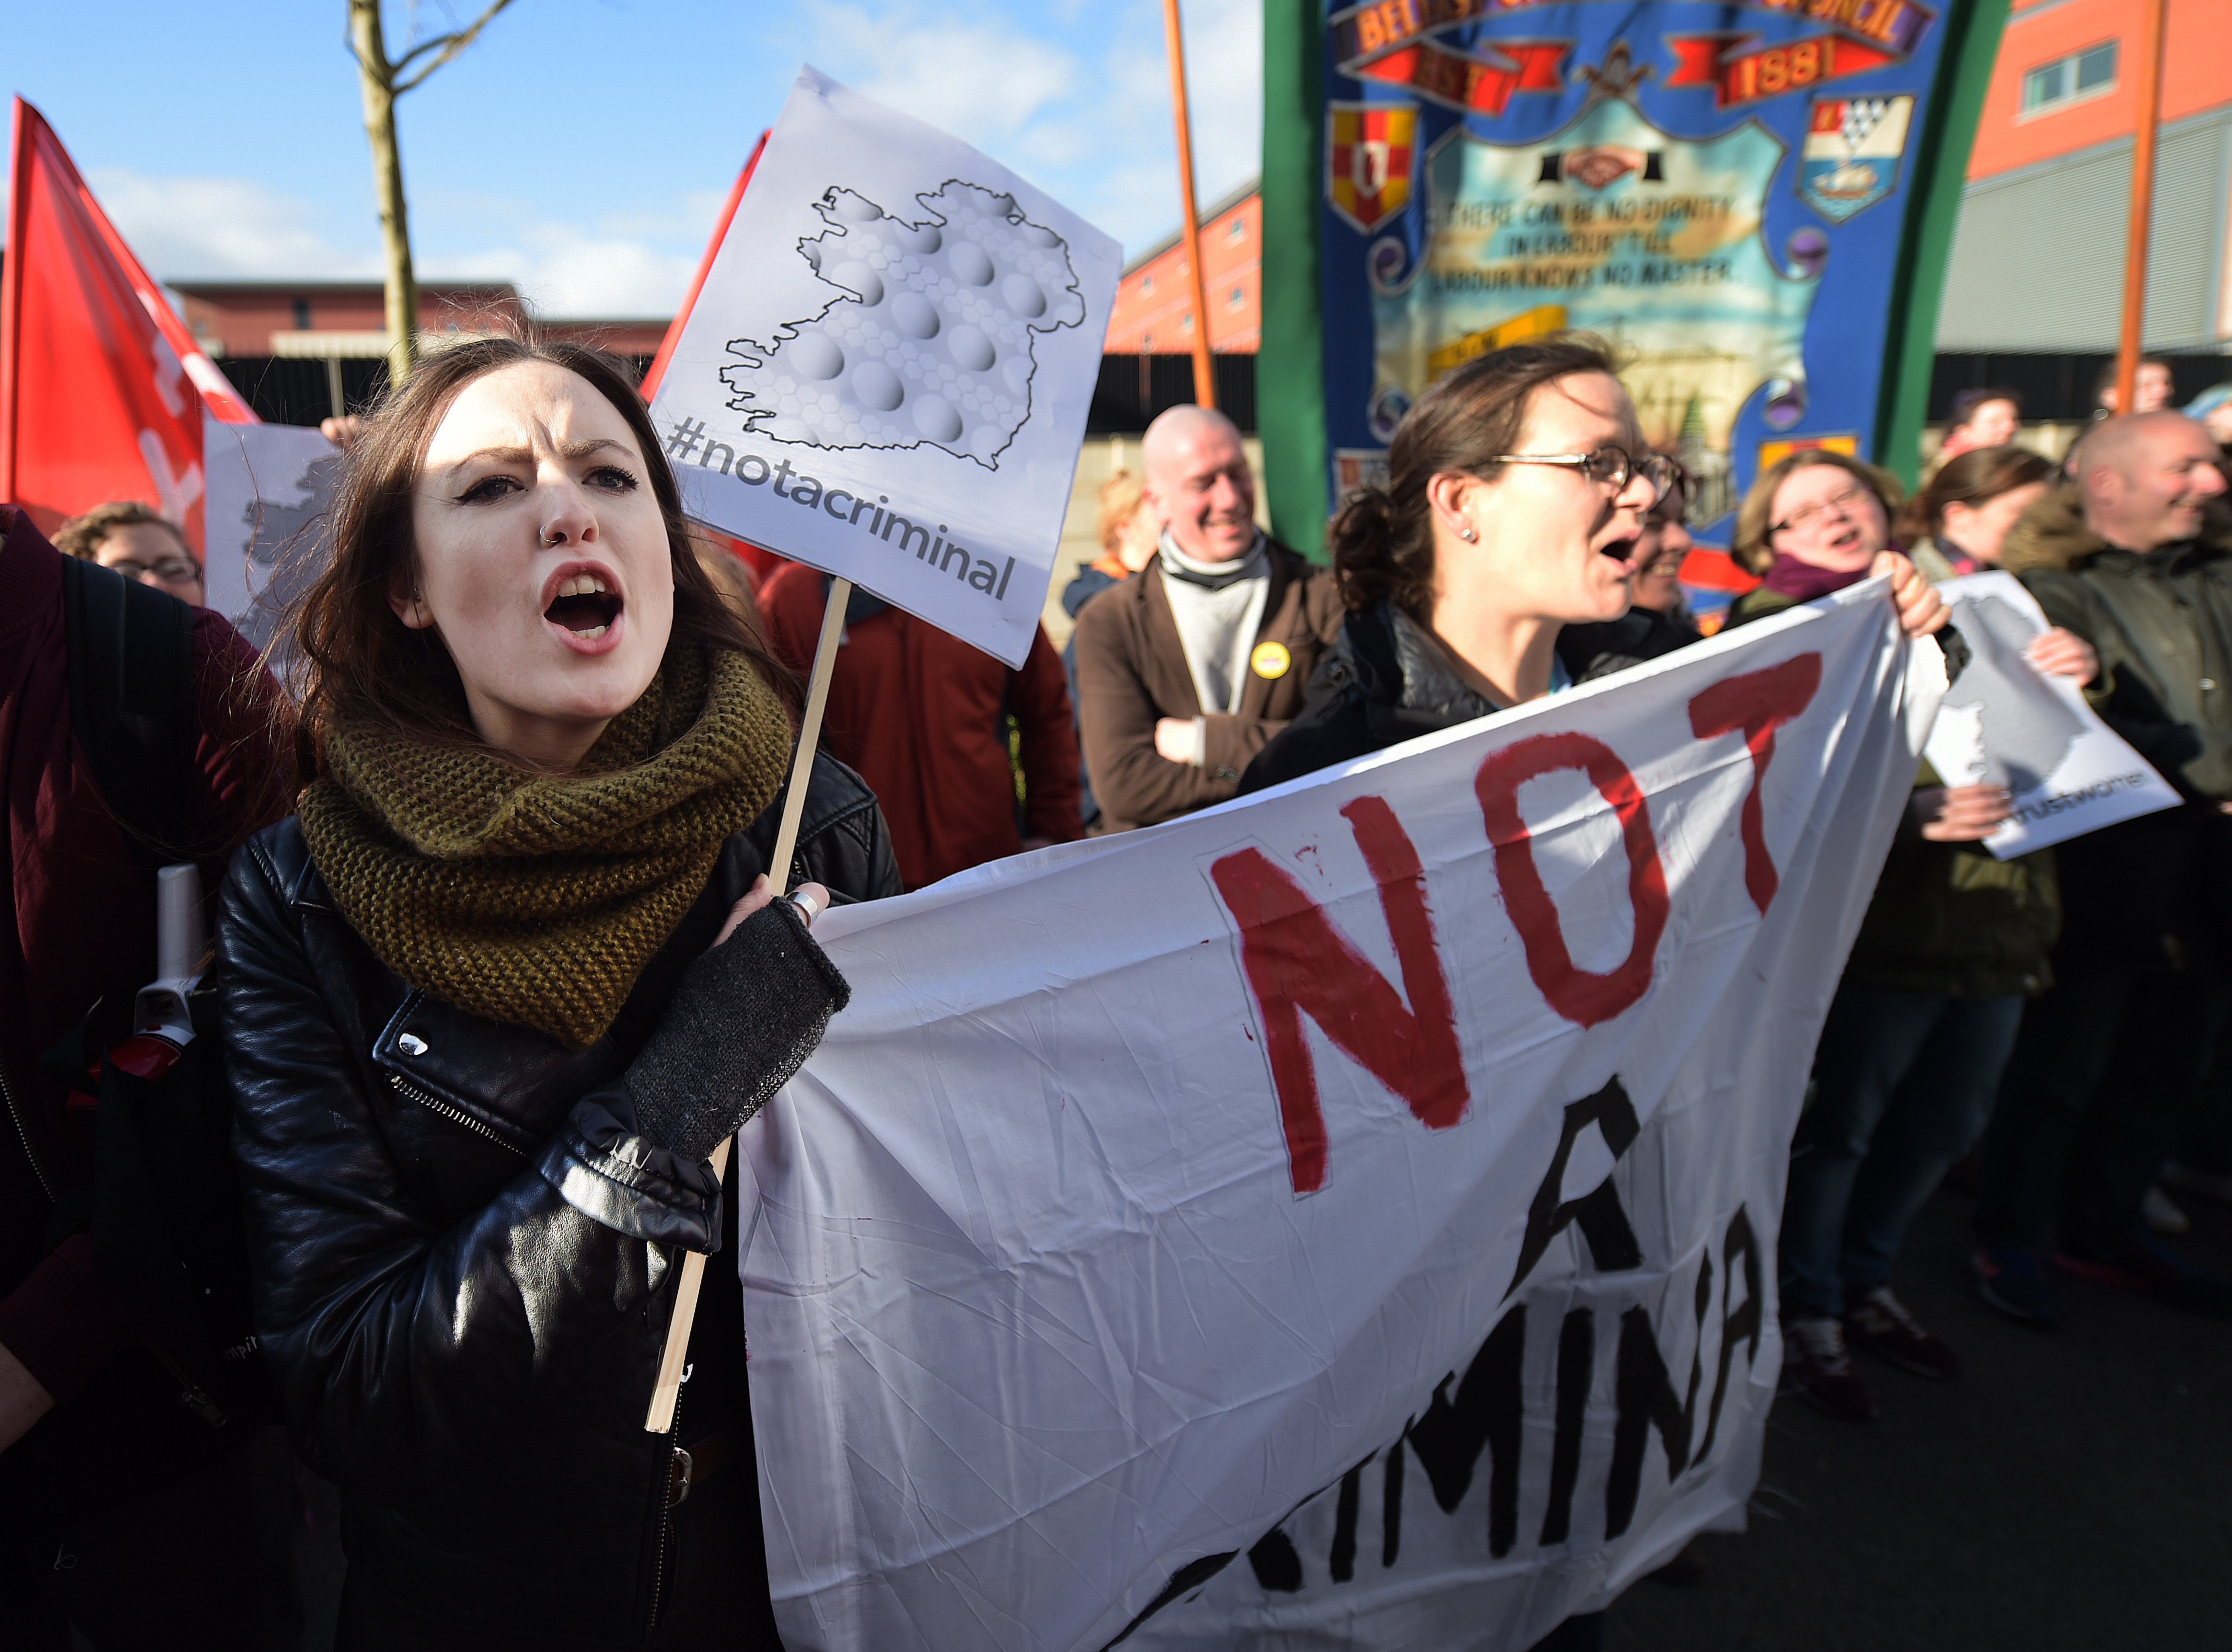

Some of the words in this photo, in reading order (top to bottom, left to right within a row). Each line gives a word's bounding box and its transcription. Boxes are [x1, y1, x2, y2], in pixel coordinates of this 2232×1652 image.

[1740, 35, 1836, 99] 1881
[1523, 200, 1564, 226] CAN
[1572, 199, 1596, 223] BE
[666, 416, 1015, 601] #notacriminal
[1210, 651, 1823, 1193] NOT
[1497, 1072, 1644, 1308] A
